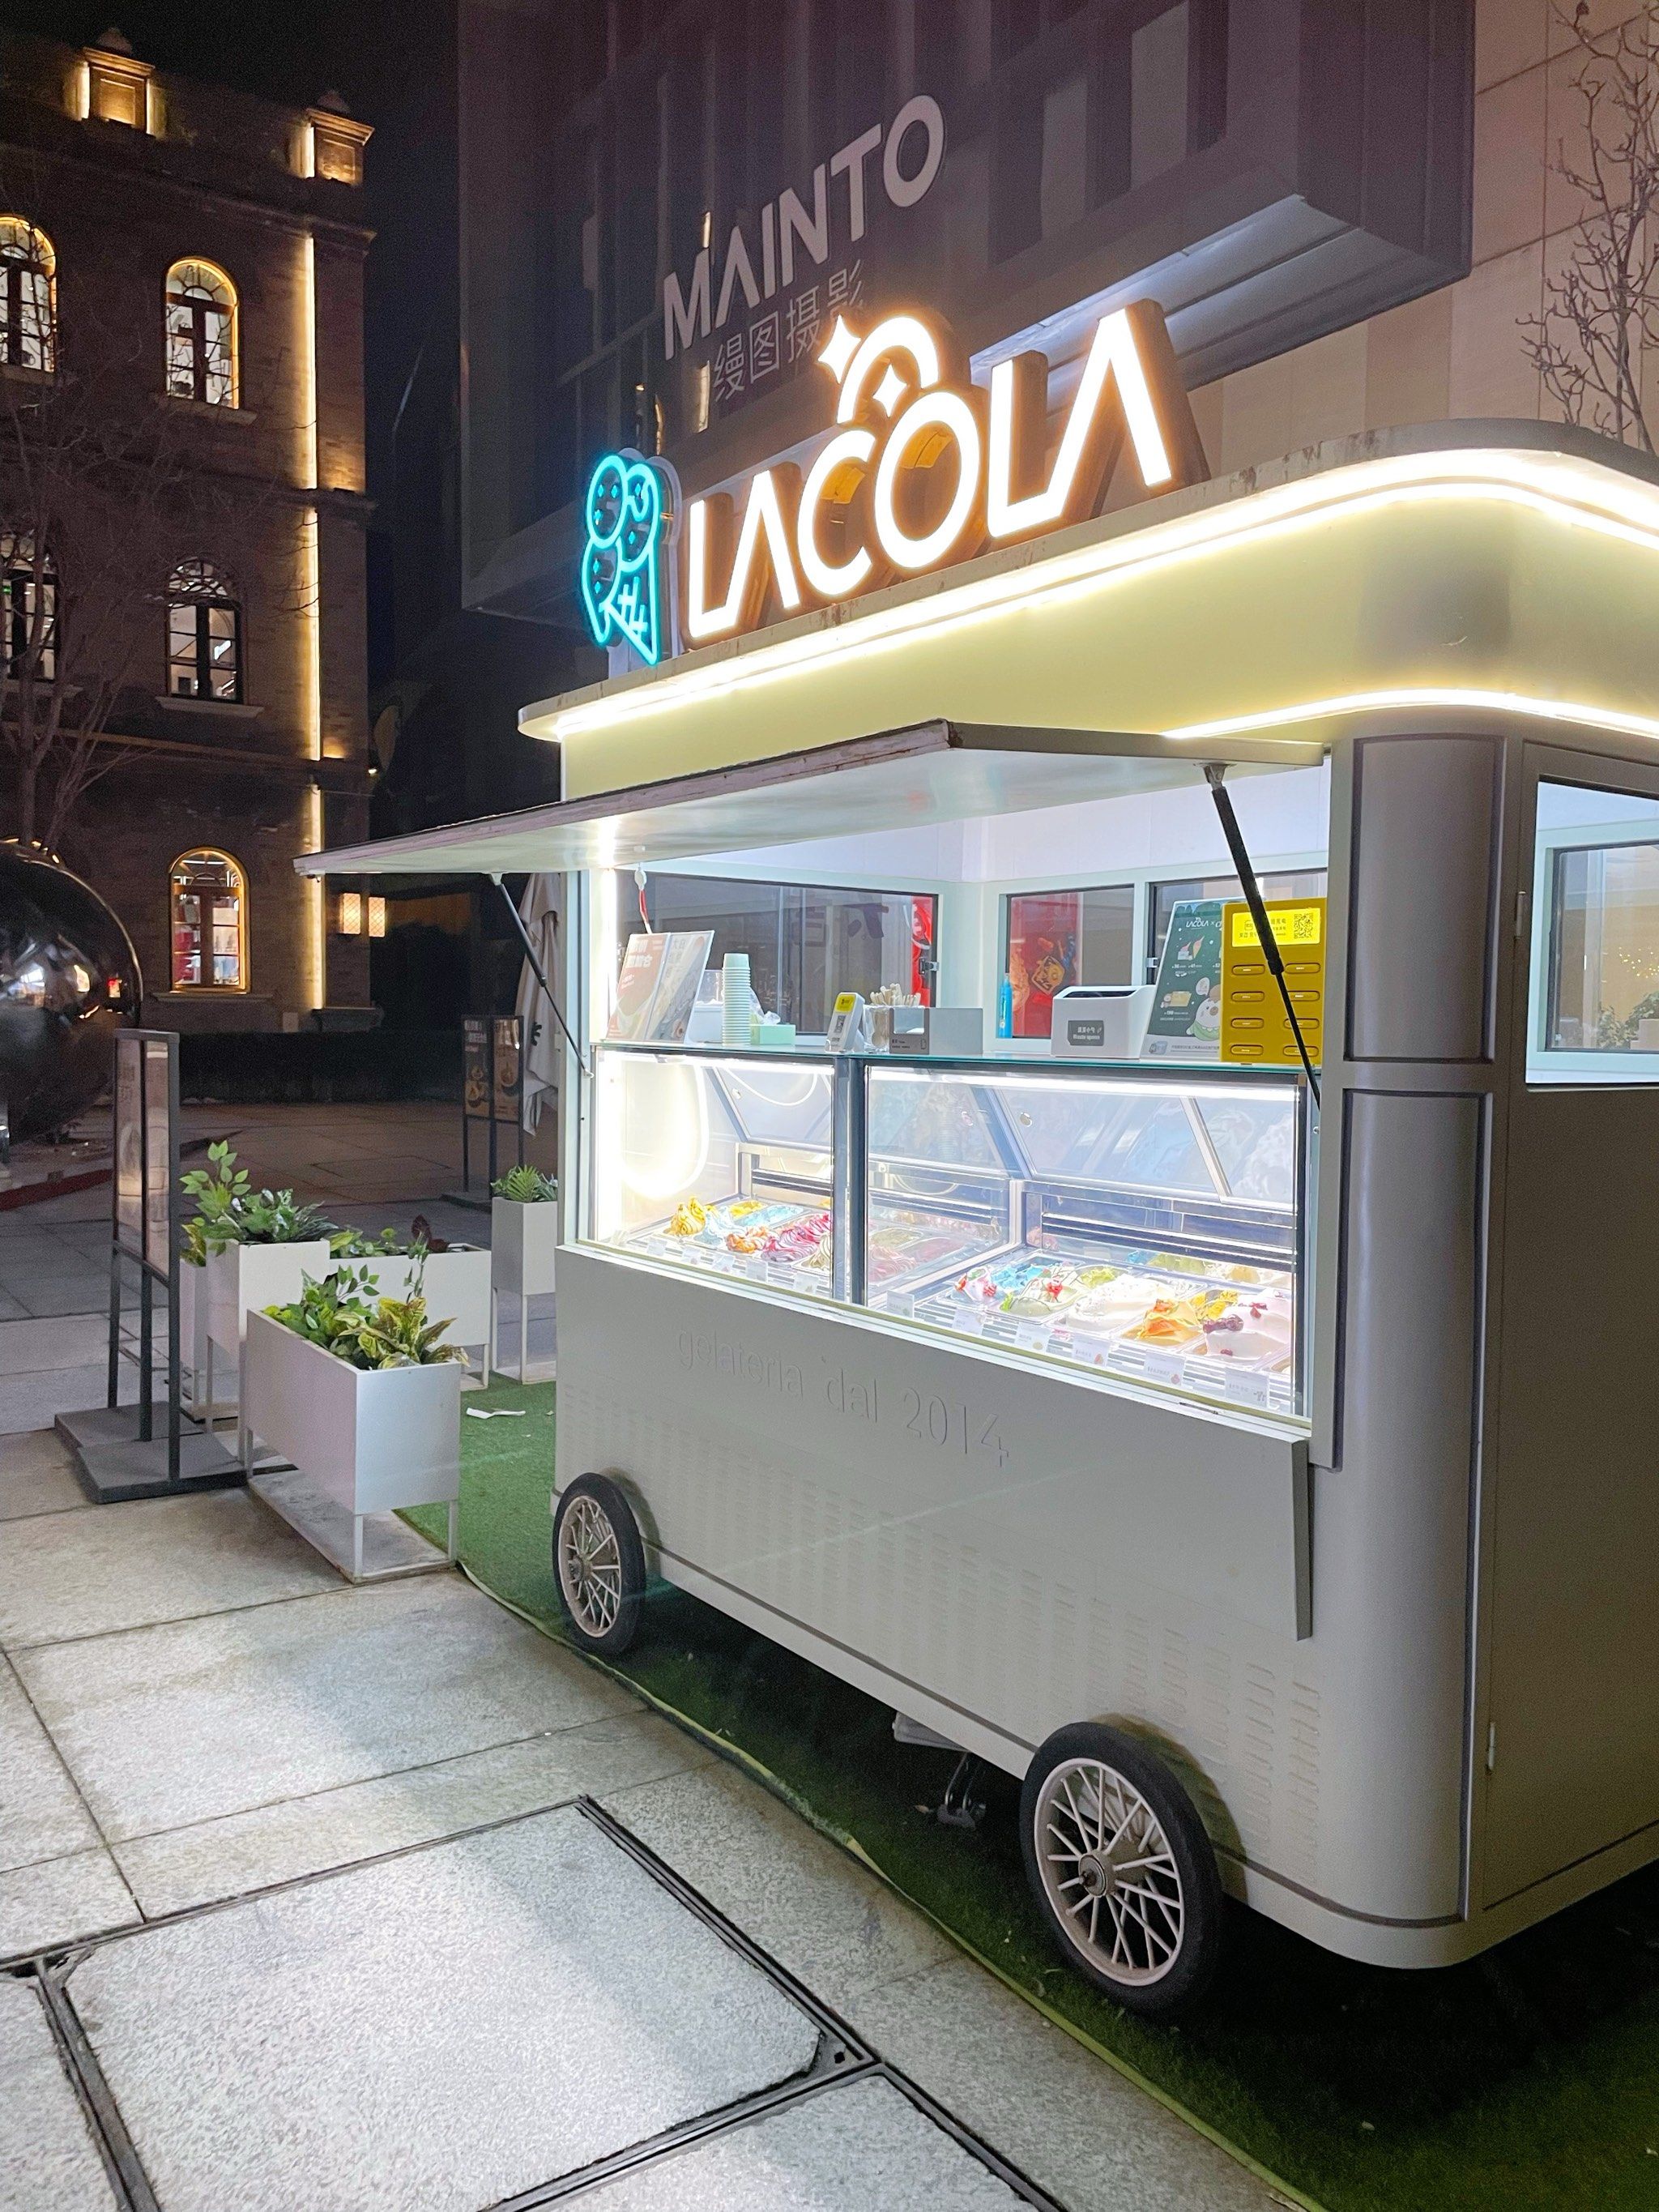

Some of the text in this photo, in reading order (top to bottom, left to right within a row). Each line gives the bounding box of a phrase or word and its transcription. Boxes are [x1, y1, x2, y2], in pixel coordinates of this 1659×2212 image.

[663, 94, 945, 361] MAINTO
[689, 307, 1173, 639] LACOLA
[902, 1386, 1009, 1467] 2014
